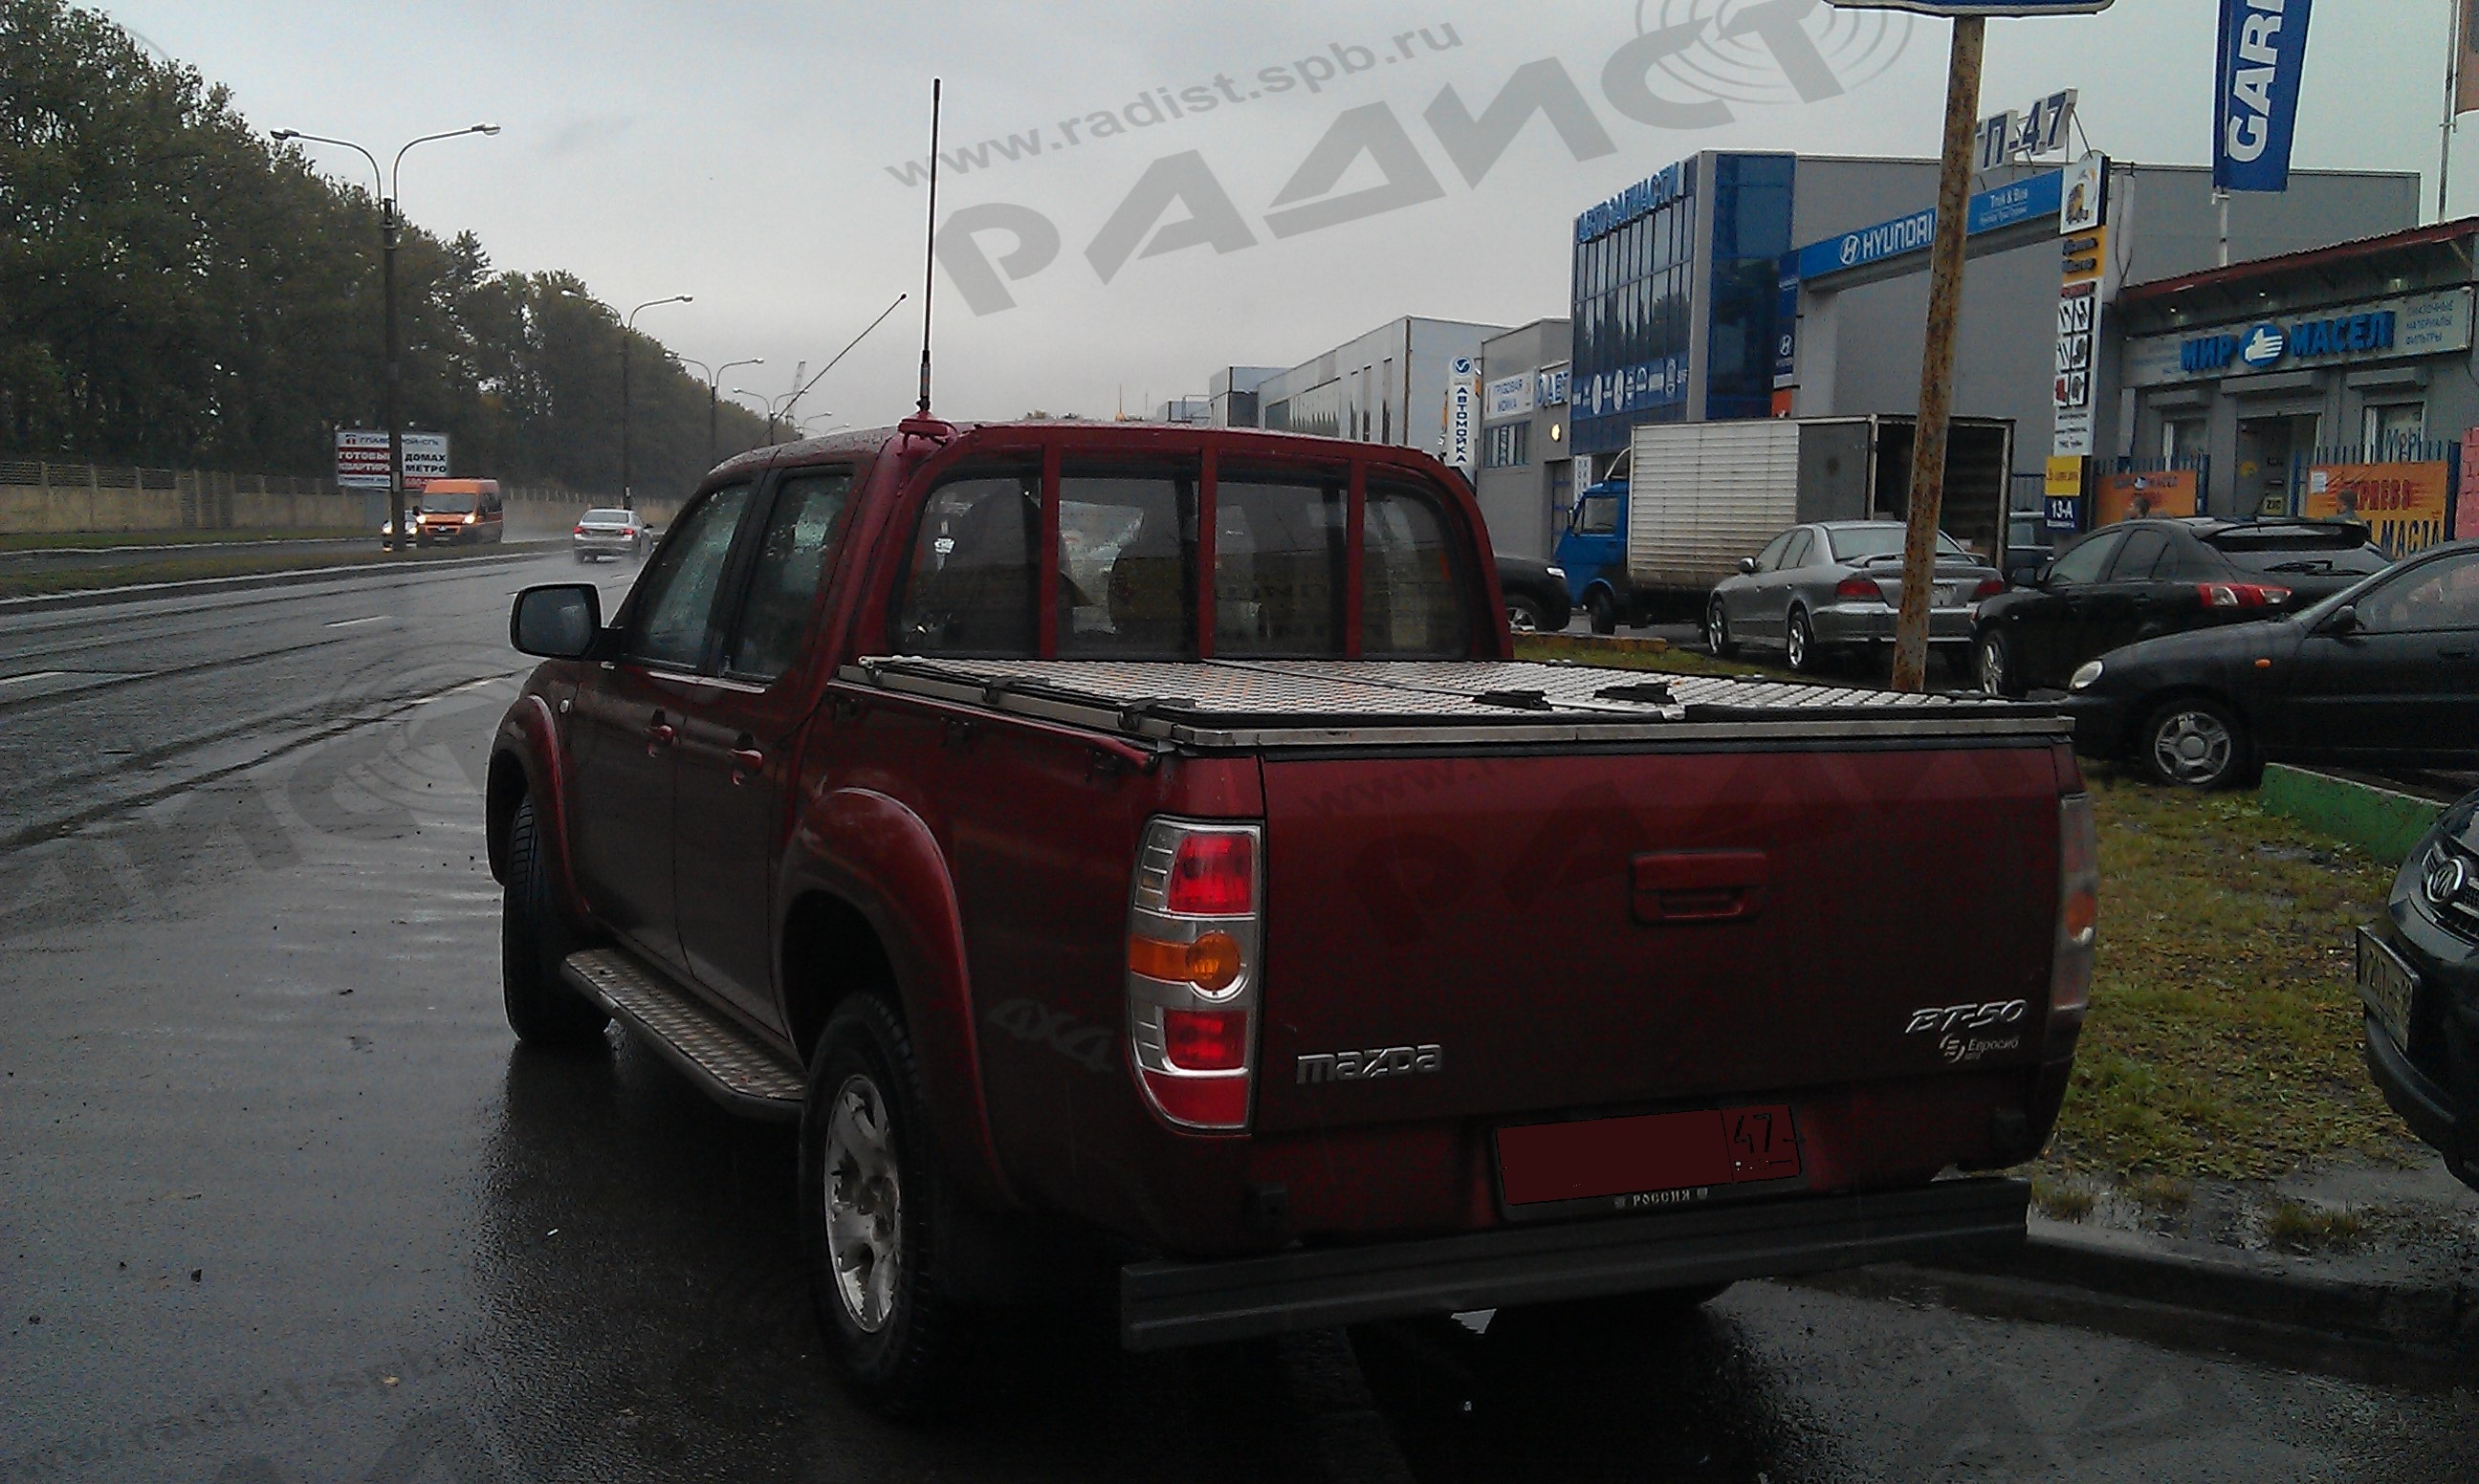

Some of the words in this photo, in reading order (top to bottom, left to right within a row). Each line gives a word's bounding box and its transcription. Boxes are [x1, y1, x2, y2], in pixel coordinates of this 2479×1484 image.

[1862, 212, 1935, 260] HYUNDAI
[2180, 334, 2235, 373] МИР
[2289, 310, 2396, 358] МАСЕЛ
[1455, 386, 1469, 463] АВТОМОЙКА
[339, 450, 390, 460] ГОТОВЫ
[405, 453, 447, 462] ДОМАХ
[405, 465, 447, 473] МЕТРО
[1904, 996, 2029, 1035] BT-50
[1295, 1042, 1444, 1085] mazda
[1632, 1189, 1691, 1208] РОССИЯ
